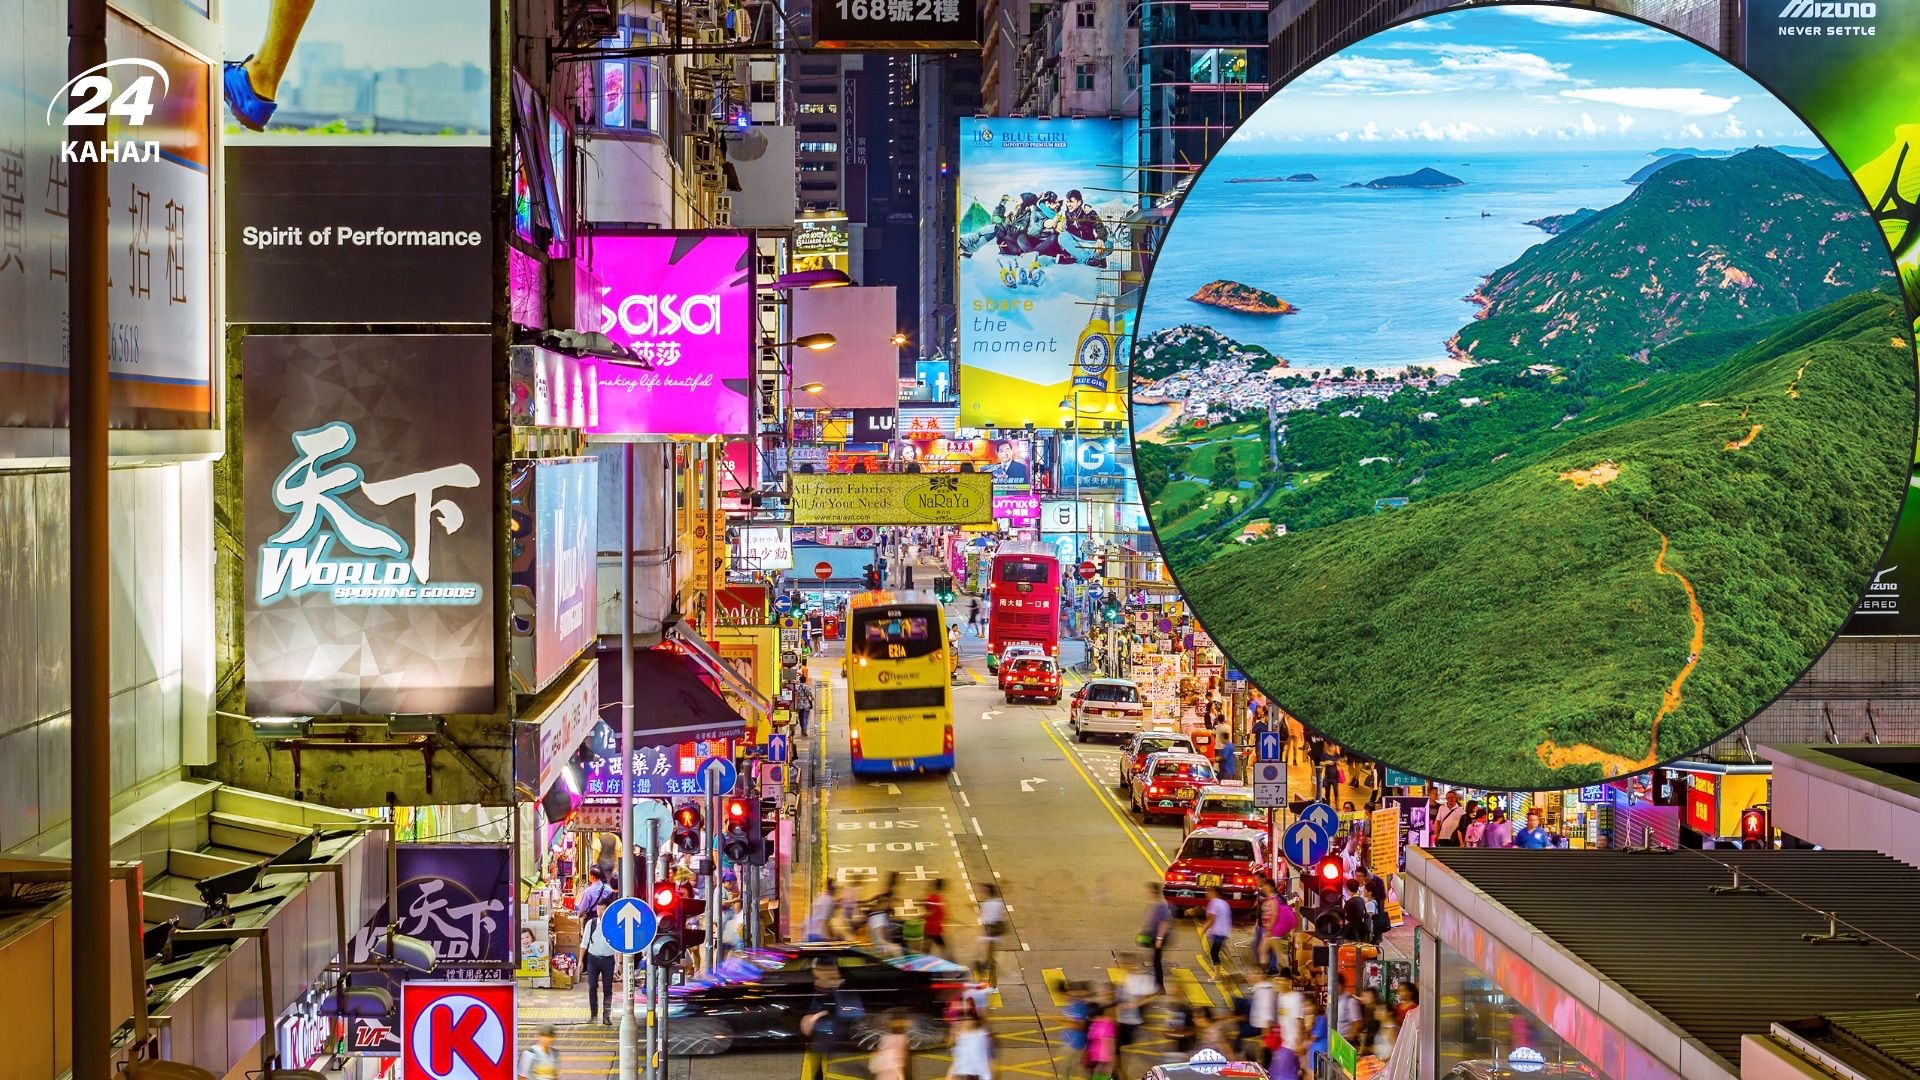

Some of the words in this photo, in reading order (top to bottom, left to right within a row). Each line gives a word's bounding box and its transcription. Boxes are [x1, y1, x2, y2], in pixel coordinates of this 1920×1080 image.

[1778, 26, 1821, 36] NEVER
[1826, 26, 1876, 36] SETTLE
[845, 78, 853, 114] GALA
[845, 118, 853, 164] PLACE
[1002, 132, 1034, 142] BLUE
[1038, 132, 1067, 142] GIRL
[242, 226, 303, 250] Spirit
[308, 226, 332, 247] of
[337, 226, 482, 247] Performance
[972, 297, 1034, 312] share
[973, 316, 1007, 332] the
[972, 339, 1058, 353] moment
[598, 376, 638, 392] making
[639, 373, 662, 392] life
[664, 373, 713, 388] beautiful
[1074, 378, 1091, 386] BLUE
[815, 482, 843, 494] from
[848, 483, 893, 494] Fabrics
[270, 423, 482, 585] 天下
[809, 497, 826, 510] for
[827, 498, 855, 509] Your
[858, 498, 892, 509] Needs
[918, 494, 969, 508] NaRaYa
[261, 536, 412, 600] WORLD
[334, 587, 417, 599] SPORTING
[420, 587, 477, 599] GOODS
[589, 753, 672, 777] 中西藥房
[589, 778, 652, 793] 政府冊
[665, 778, 704, 793] 免稅
[1274, 785, 1281, 794] 7
[1275, 797, 1285, 805] 12
[836, 819, 921, 831] BUS
[827, 841, 940, 853] STOP
[408, 879, 505, 959] 天下
[355, 1026, 392, 1047] 1/F
[430, 1004, 502, 1077] K
